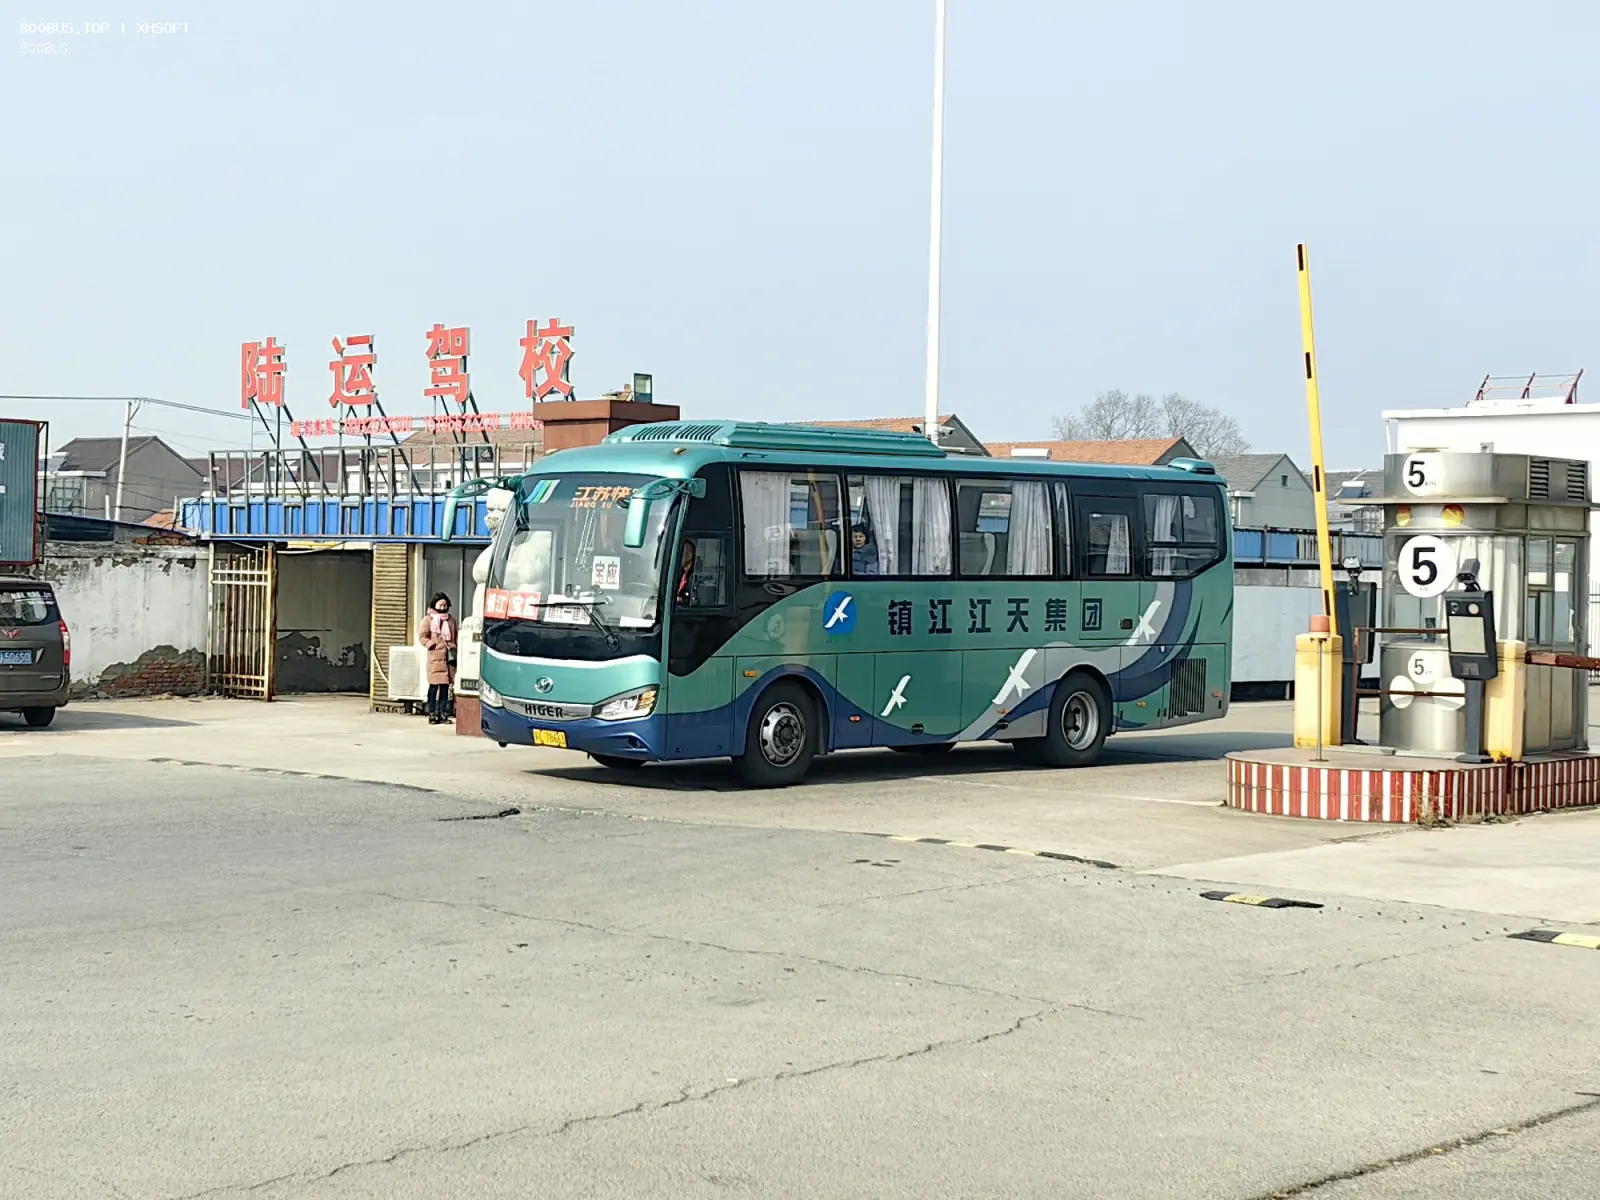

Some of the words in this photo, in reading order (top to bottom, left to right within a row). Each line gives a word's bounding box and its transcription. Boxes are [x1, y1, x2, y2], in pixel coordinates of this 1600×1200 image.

[241, 318, 576, 409] 陆运驾校
[1408, 460, 1425, 487] 5
[572, 485, 640, 502] 江苏快
[1412, 546, 1438, 586] 5
[888, 597, 1103, 636] 镇江江天集团
[1414, 658, 1424, 675] 5
[525, 704, 563, 718] HIGER
